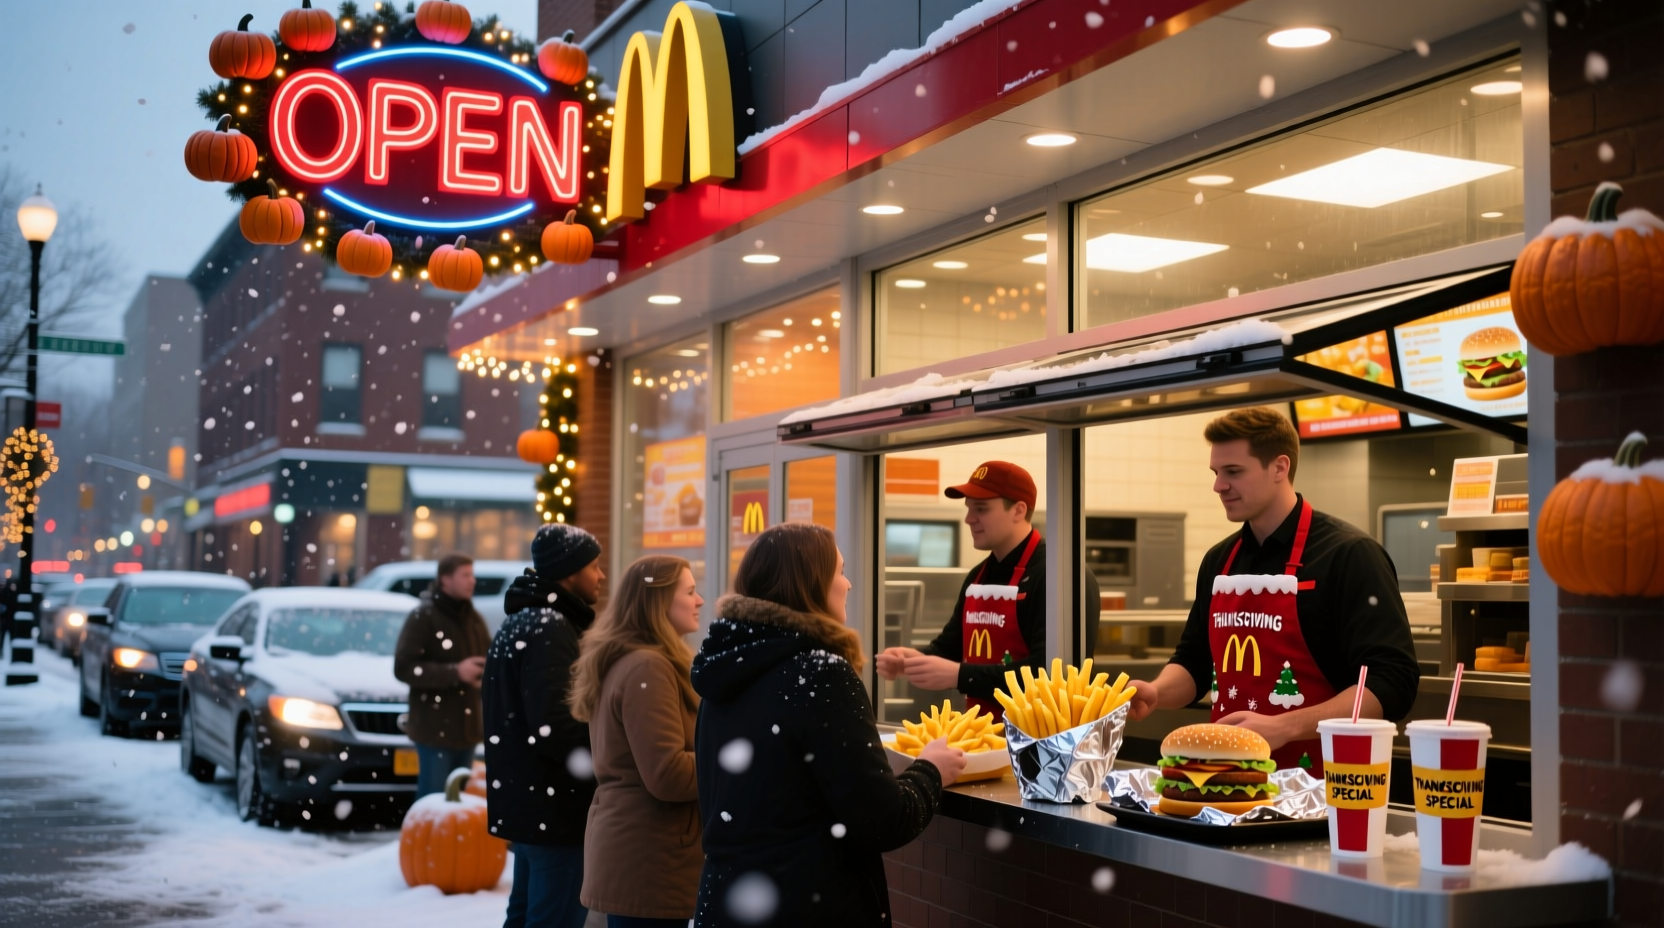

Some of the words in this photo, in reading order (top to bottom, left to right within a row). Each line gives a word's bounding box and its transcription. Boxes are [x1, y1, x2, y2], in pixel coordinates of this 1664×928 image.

[269, 68, 582, 204] OPEN
[1332, 787, 1374, 801] SPECIAL
[1425, 794, 1475, 809] SPECIAL
